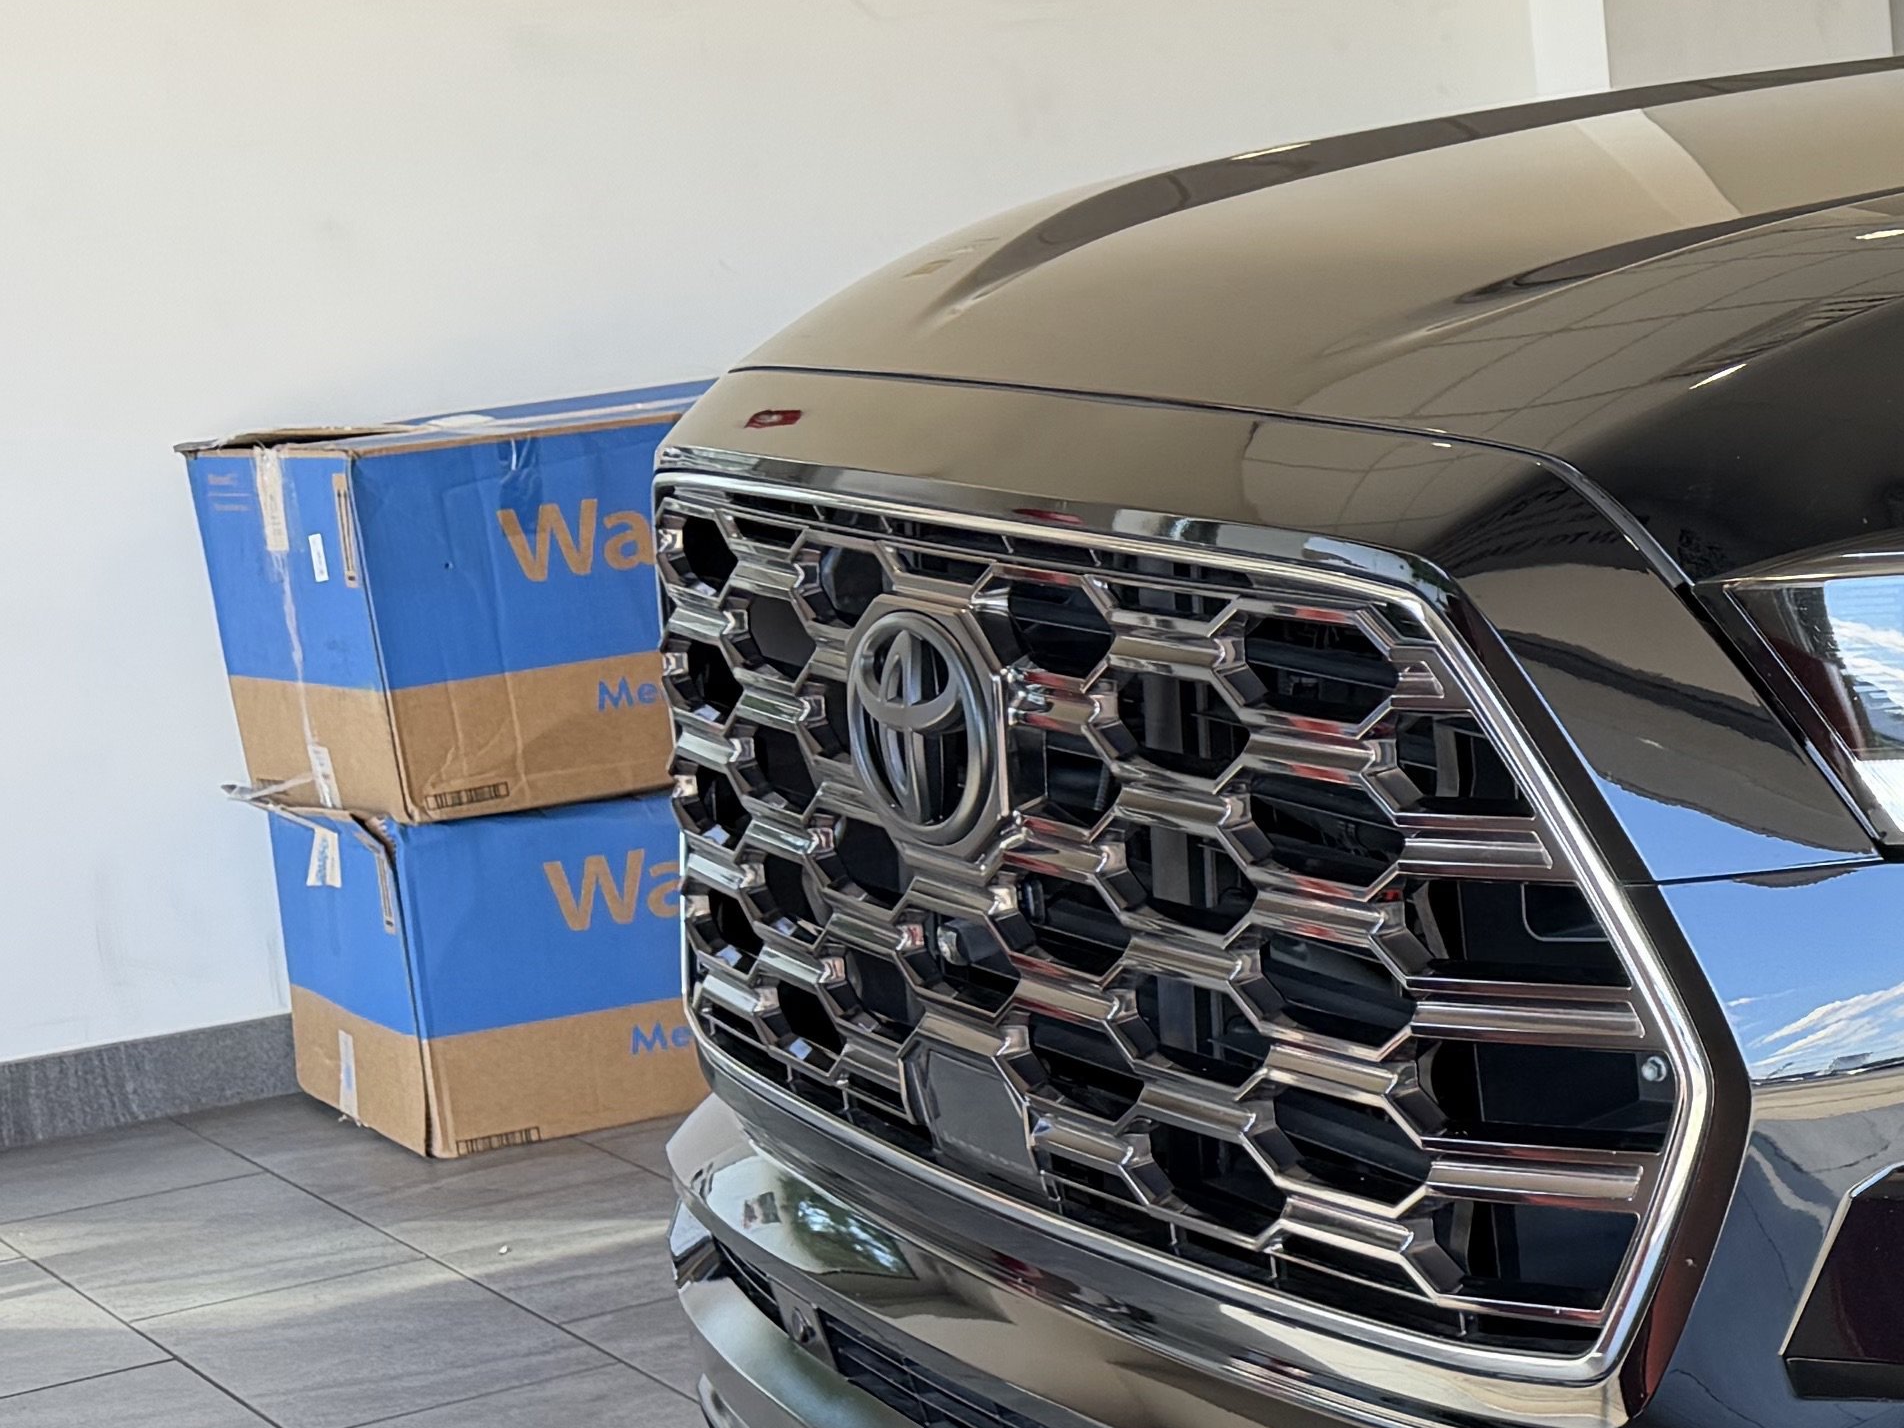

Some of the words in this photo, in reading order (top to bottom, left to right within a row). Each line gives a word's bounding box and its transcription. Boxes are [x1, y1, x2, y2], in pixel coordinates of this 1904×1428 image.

[496, 498, 657, 583] Wa
[597, 675, 659, 712] Me
[630, 1021, 693, 1055] Me
